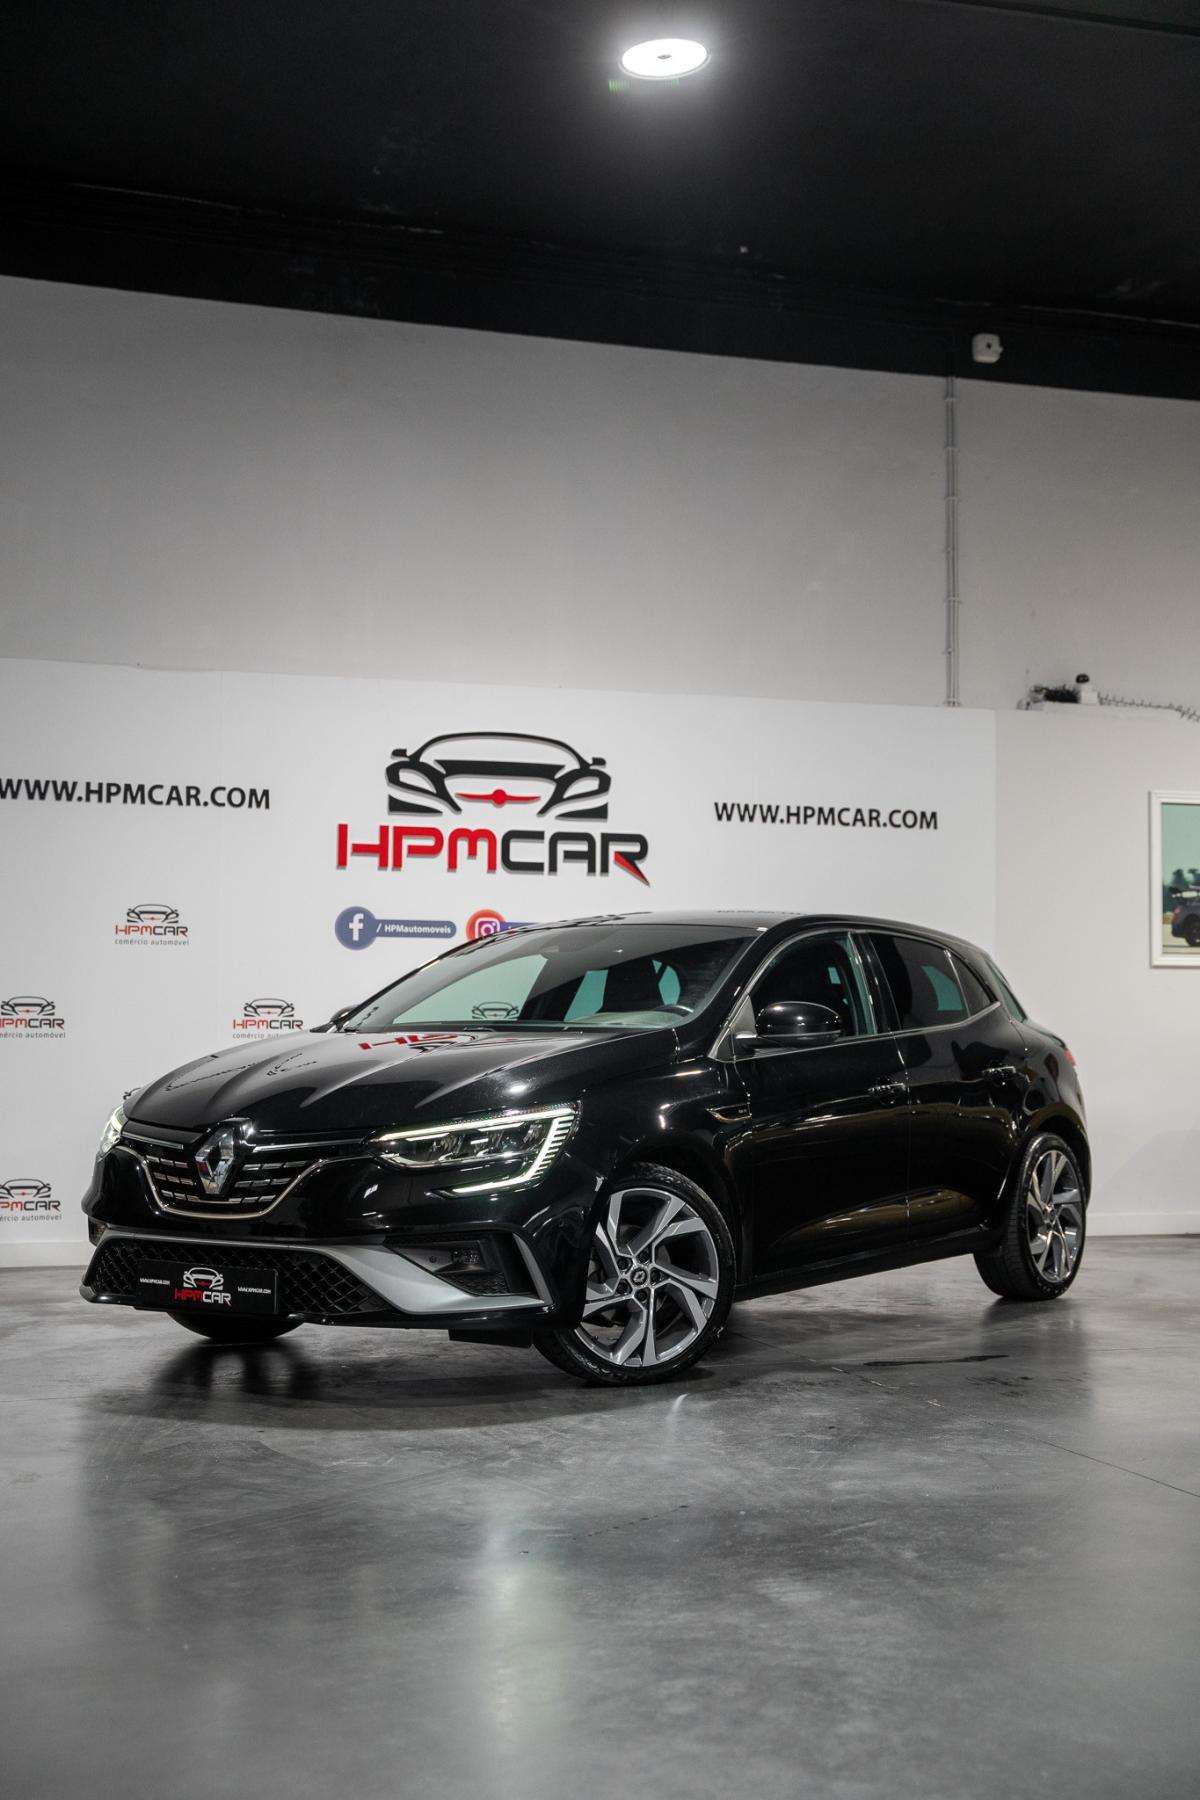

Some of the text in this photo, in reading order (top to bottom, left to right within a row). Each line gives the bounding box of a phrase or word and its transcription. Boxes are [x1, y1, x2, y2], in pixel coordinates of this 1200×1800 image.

[0, 778, 270, 810] WWW.HPMCAR.COM
[714, 802, 938, 830] WWW.HPMCAR.COM
[337, 823, 650, 887] HPMCAR
[115, 925, 188, 937] HPMCAR
[384, 924, 451, 934] HPMautomoveis
[233, 1019, 304, 1030] HPMCAR
[0, 1200, 61, 1212] PMCAR
[174, 1288, 232, 1307] HPMCAR
